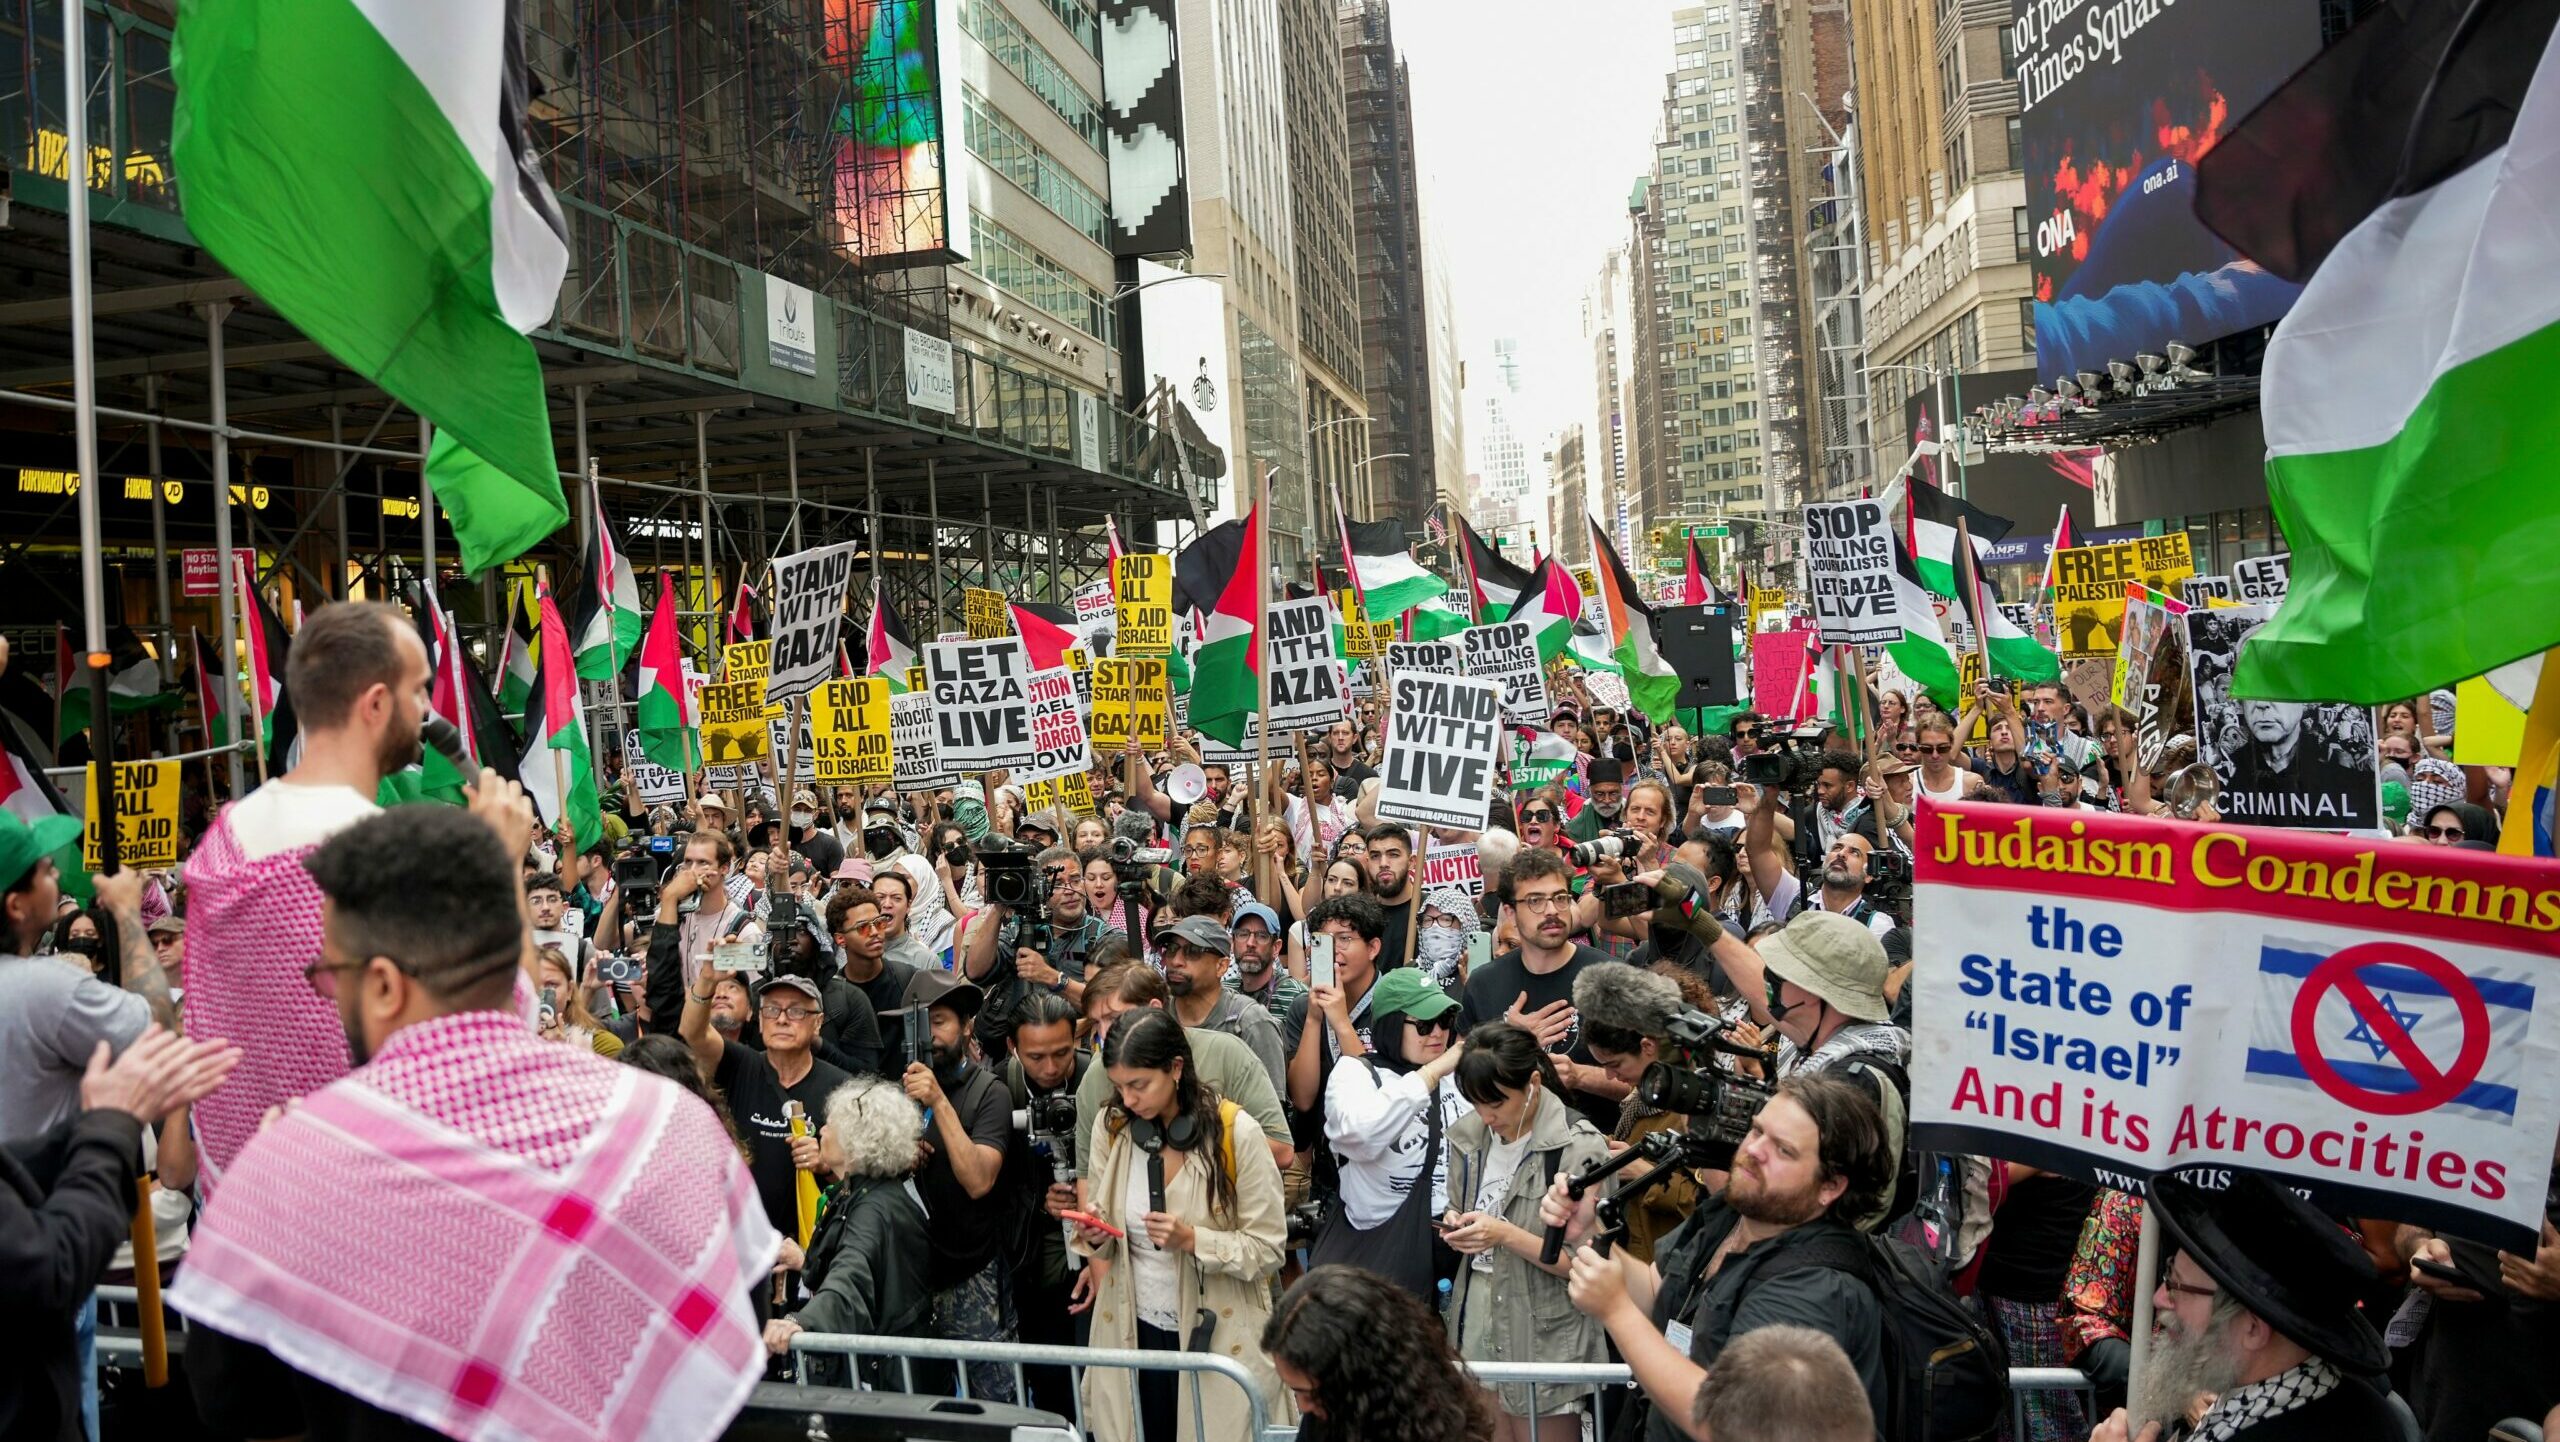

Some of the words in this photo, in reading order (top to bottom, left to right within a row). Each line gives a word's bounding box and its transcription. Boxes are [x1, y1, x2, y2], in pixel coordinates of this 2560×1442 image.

[2017, 34, 2085, 112] Times
[2086, 0, 2176, 64] Squar
[2143, 159, 2179, 194] ona.ai
[2037, 208, 2075, 257] ONA
[777, 319, 806, 344] Tribute
[1027, 321, 1090, 367] SQUARE
[920, 364, 952, 396] Tribute
[1806, 504, 1881, 539] STOP
[186, 554, 199, 564] NO
[1809, 536, 1888, 558] KILLING
[2140, 535, 2186, 560] FREE
[187, 564, 219, 577] Anytim
[781, 551, 849, 600] STAND
[1121, 556, 1153, 580] END
[1812, 555, 1889, 572] JOURNALISTS
[2058, 546, 2136, 584] FREE
[2142, 555, 2191, 573] ALESTINE
[2238, 557, 2291, 584] LET
[1074, 582, 1101, 597] LIFT
[1121, 580, 1151, 603] ALL
[1815, 578, 1838, 595] LET
[1839, 574, 1893, 596] GAZA
[2057, 580, 2127, 603] PALESTIN
[2185, 581, 2228, 606] STOP
[2244, 582, 2287, 599] GAZ
[780, 583, 845, 628] WITH
[967, 604, 986, 616] END
[988, 607, 1004, 620] THE
[1080, 611, 1100, 621] ON
[1137, 608, 1167, 627] AID
[1817, 593, 1897, 618] LIVE
[968, 622, 1004, 638] NOW!
[1372, 624, 1391, 638] AID
[1465, 622, 1530, 653] STOP
[774, 617, 837, 676] GAZA
[1268, 634, 1330, 665] ITH
[1346, 640, 1356, 650] TO
[1388, 644, 1452, 666] STOP
[1466, 646, 1535, 667] KILLING
[931, 643, 1019, 680] LET
[1096, 660, 1162, 686] STOP
[1468, 659, 1536, 676] JOURNALISTS
[702, 682, 759, 711] FREE
[827, 682, 871, 707] END
[935, 678, 1024, 705] GAZA
[1270, 665, 1338, 708] AZA
[1396, 679, 1497, 722] STAND
[701, 705, 763, 725] PALESTINE
[832, 707, 870, 733] ALL
[938, 706, 1030, 747] LIVE
[1395, 713, 1494, 752] WITH
[816, 737, 852, 758] U.S.
[857, 734, 887, 756] AID
[709, 761, 753, 779] PALESTNE
[816, 760, 833, 775] TO
[838, 757, 889, 775] ISRAEL!
[942, 755, 1033, 770] #SHUTITDOWN4PALESTINE
[1386, 747, 1488, 801] LIVE
[114, 764, 159, 790] END
[1064, 775, 1085, 793] AID
[114, 790, 155, 816] ALL
[1380, 803, 1481, 827] #SHUTITDOWN4PALESTINE
[2215, 791, 2358, 817] CRIMINAL
[137, 818, 171, 840] AID
[116, 841, 172, 861] SRAEL!
[1460, 847, 1476, 856] MUST
[1934, 813, 2176, 884] Judaism
[2191, 832, 2560, 933] Condemns
[2027, 905, 2123, 958] the
[1958, 954, 2112, 1016] State
[2130, 984, 2192, 1032] of
[1950, 1066, 2063, 1131] And
[2081, 1087, 2150, 1153] its
[2167, 1104, 2507, 1201] Atrocities
